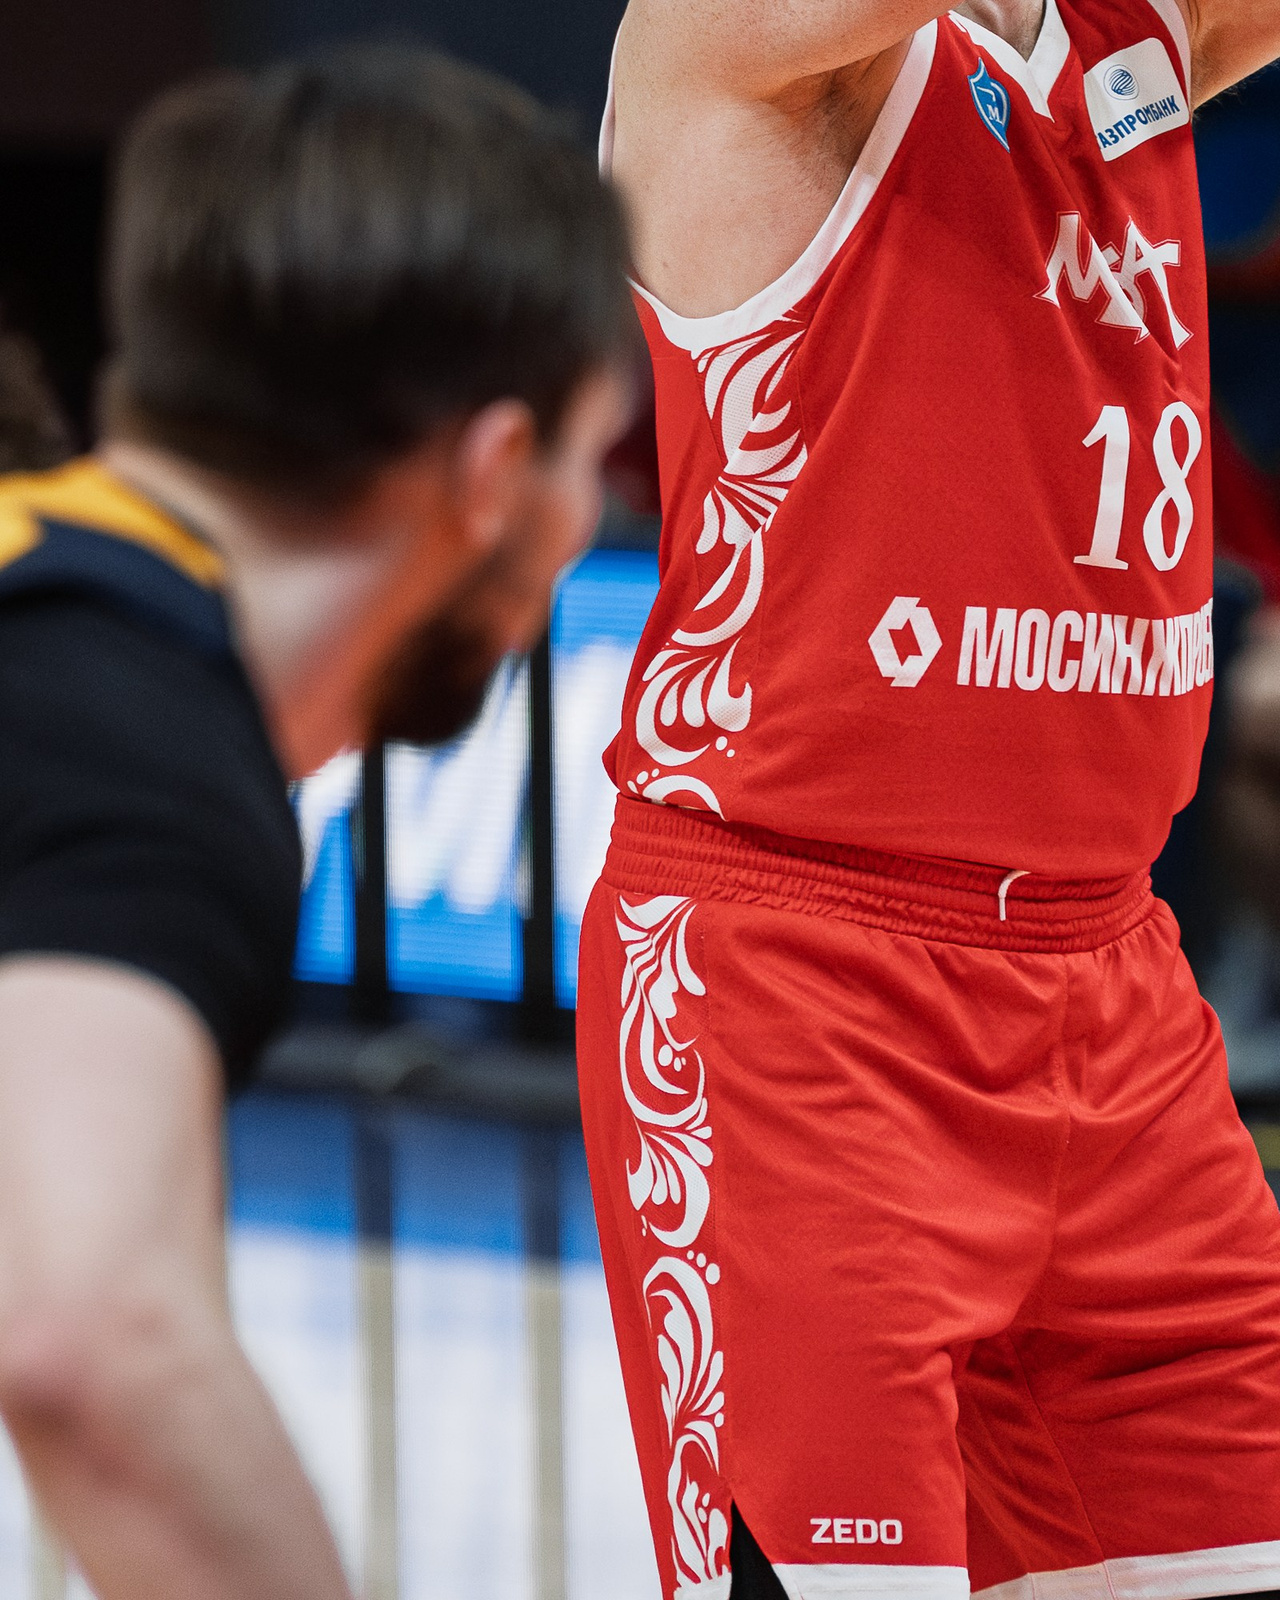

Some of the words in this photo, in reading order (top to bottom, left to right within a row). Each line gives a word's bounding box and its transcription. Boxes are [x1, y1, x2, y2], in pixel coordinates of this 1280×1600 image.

[1097, 95, 1181, 149] АЗПРОМБАНК
[1073, 401, 1202, 571] 18
[810, 1518, 903, 1545] ZEDO
